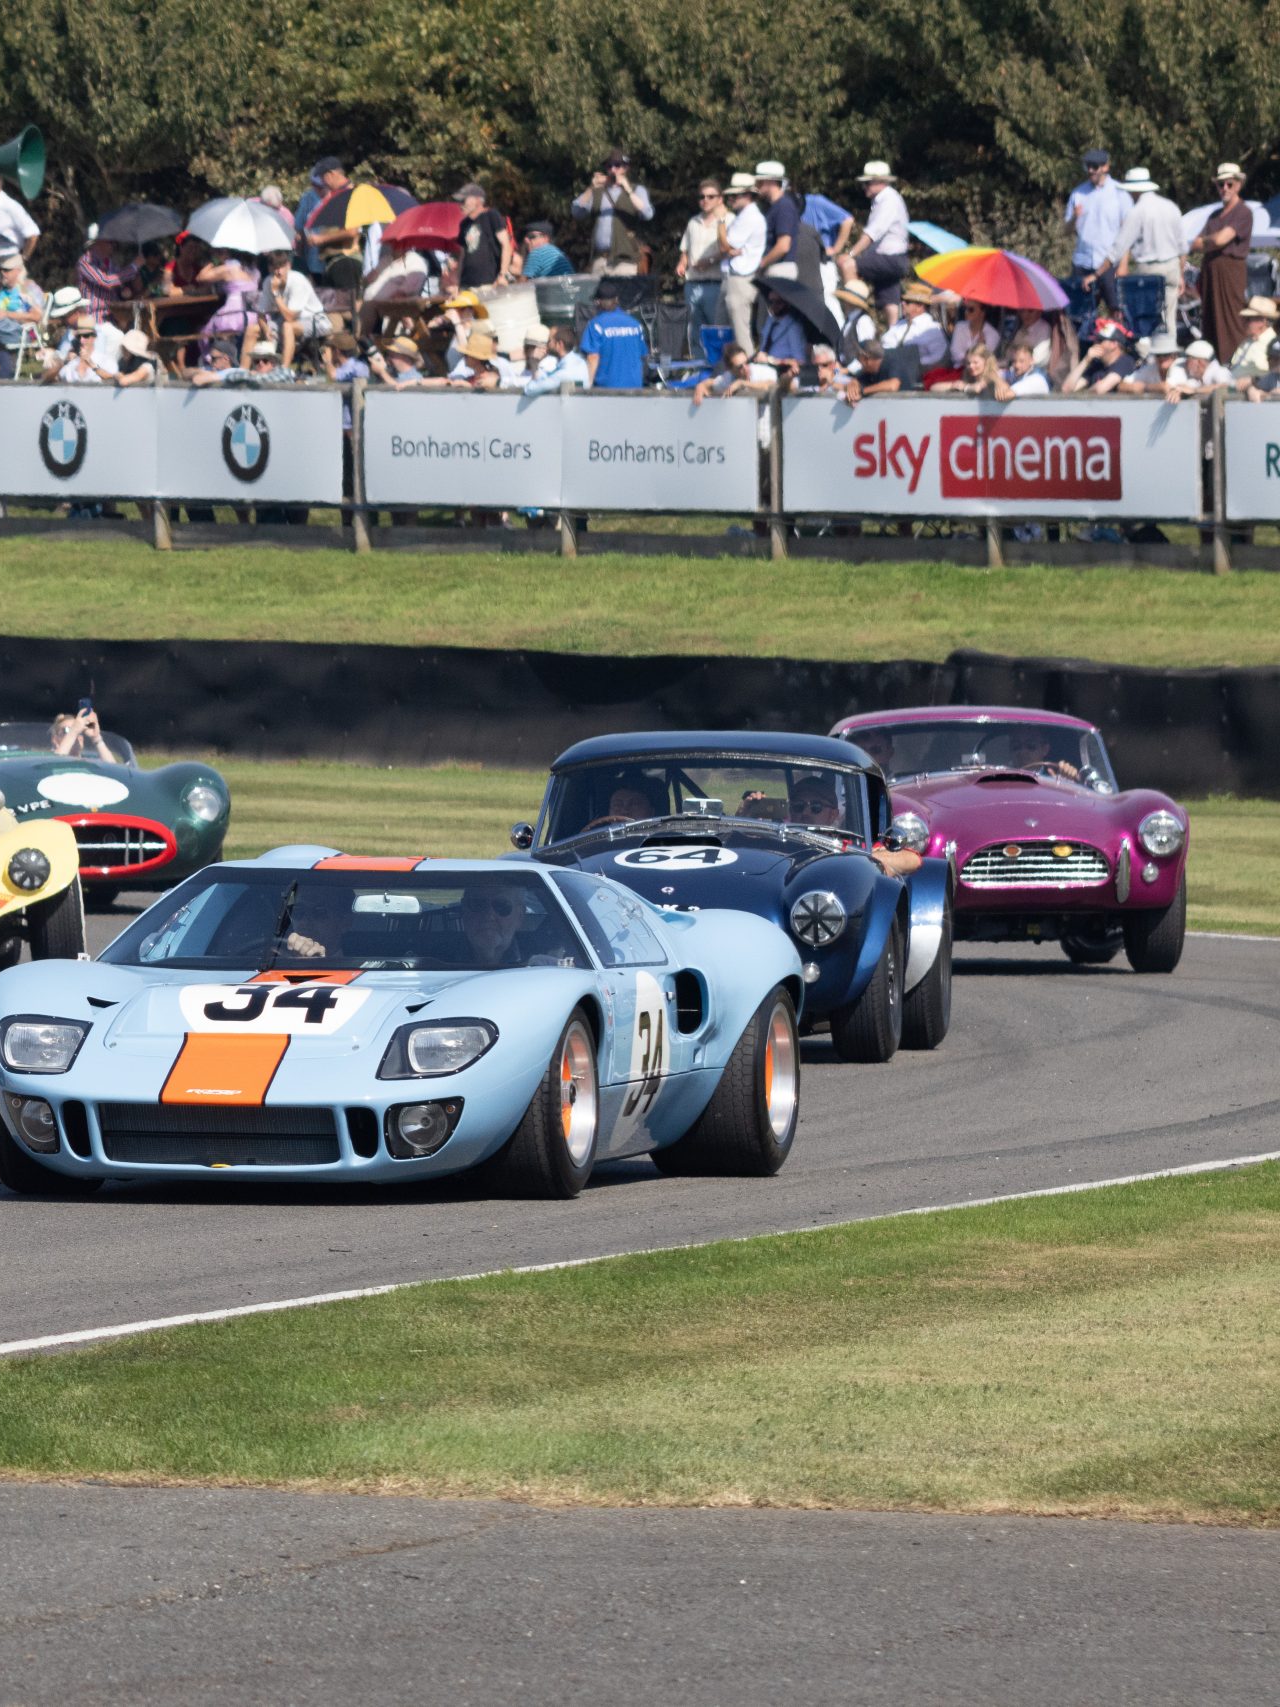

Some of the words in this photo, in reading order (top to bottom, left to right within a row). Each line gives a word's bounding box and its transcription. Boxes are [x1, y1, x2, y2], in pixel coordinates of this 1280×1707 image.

[41, 402, 87, 429] BMW
[225, 405, 268, 433] BMW
[391, 435, 480, 459] Bonhams
[489, 437, 532, 460] Cars
[588, 440, 675, 464] Bonhams
[683, 441, 726, 465] Cars
[853, 418, 930, 495] sky
[949, 424, 1111, 482] cinema
[624, 848, 722, 864] 64
[203, 984, 342, 1024] 34
[622, 1009, 663, 1117] 34
